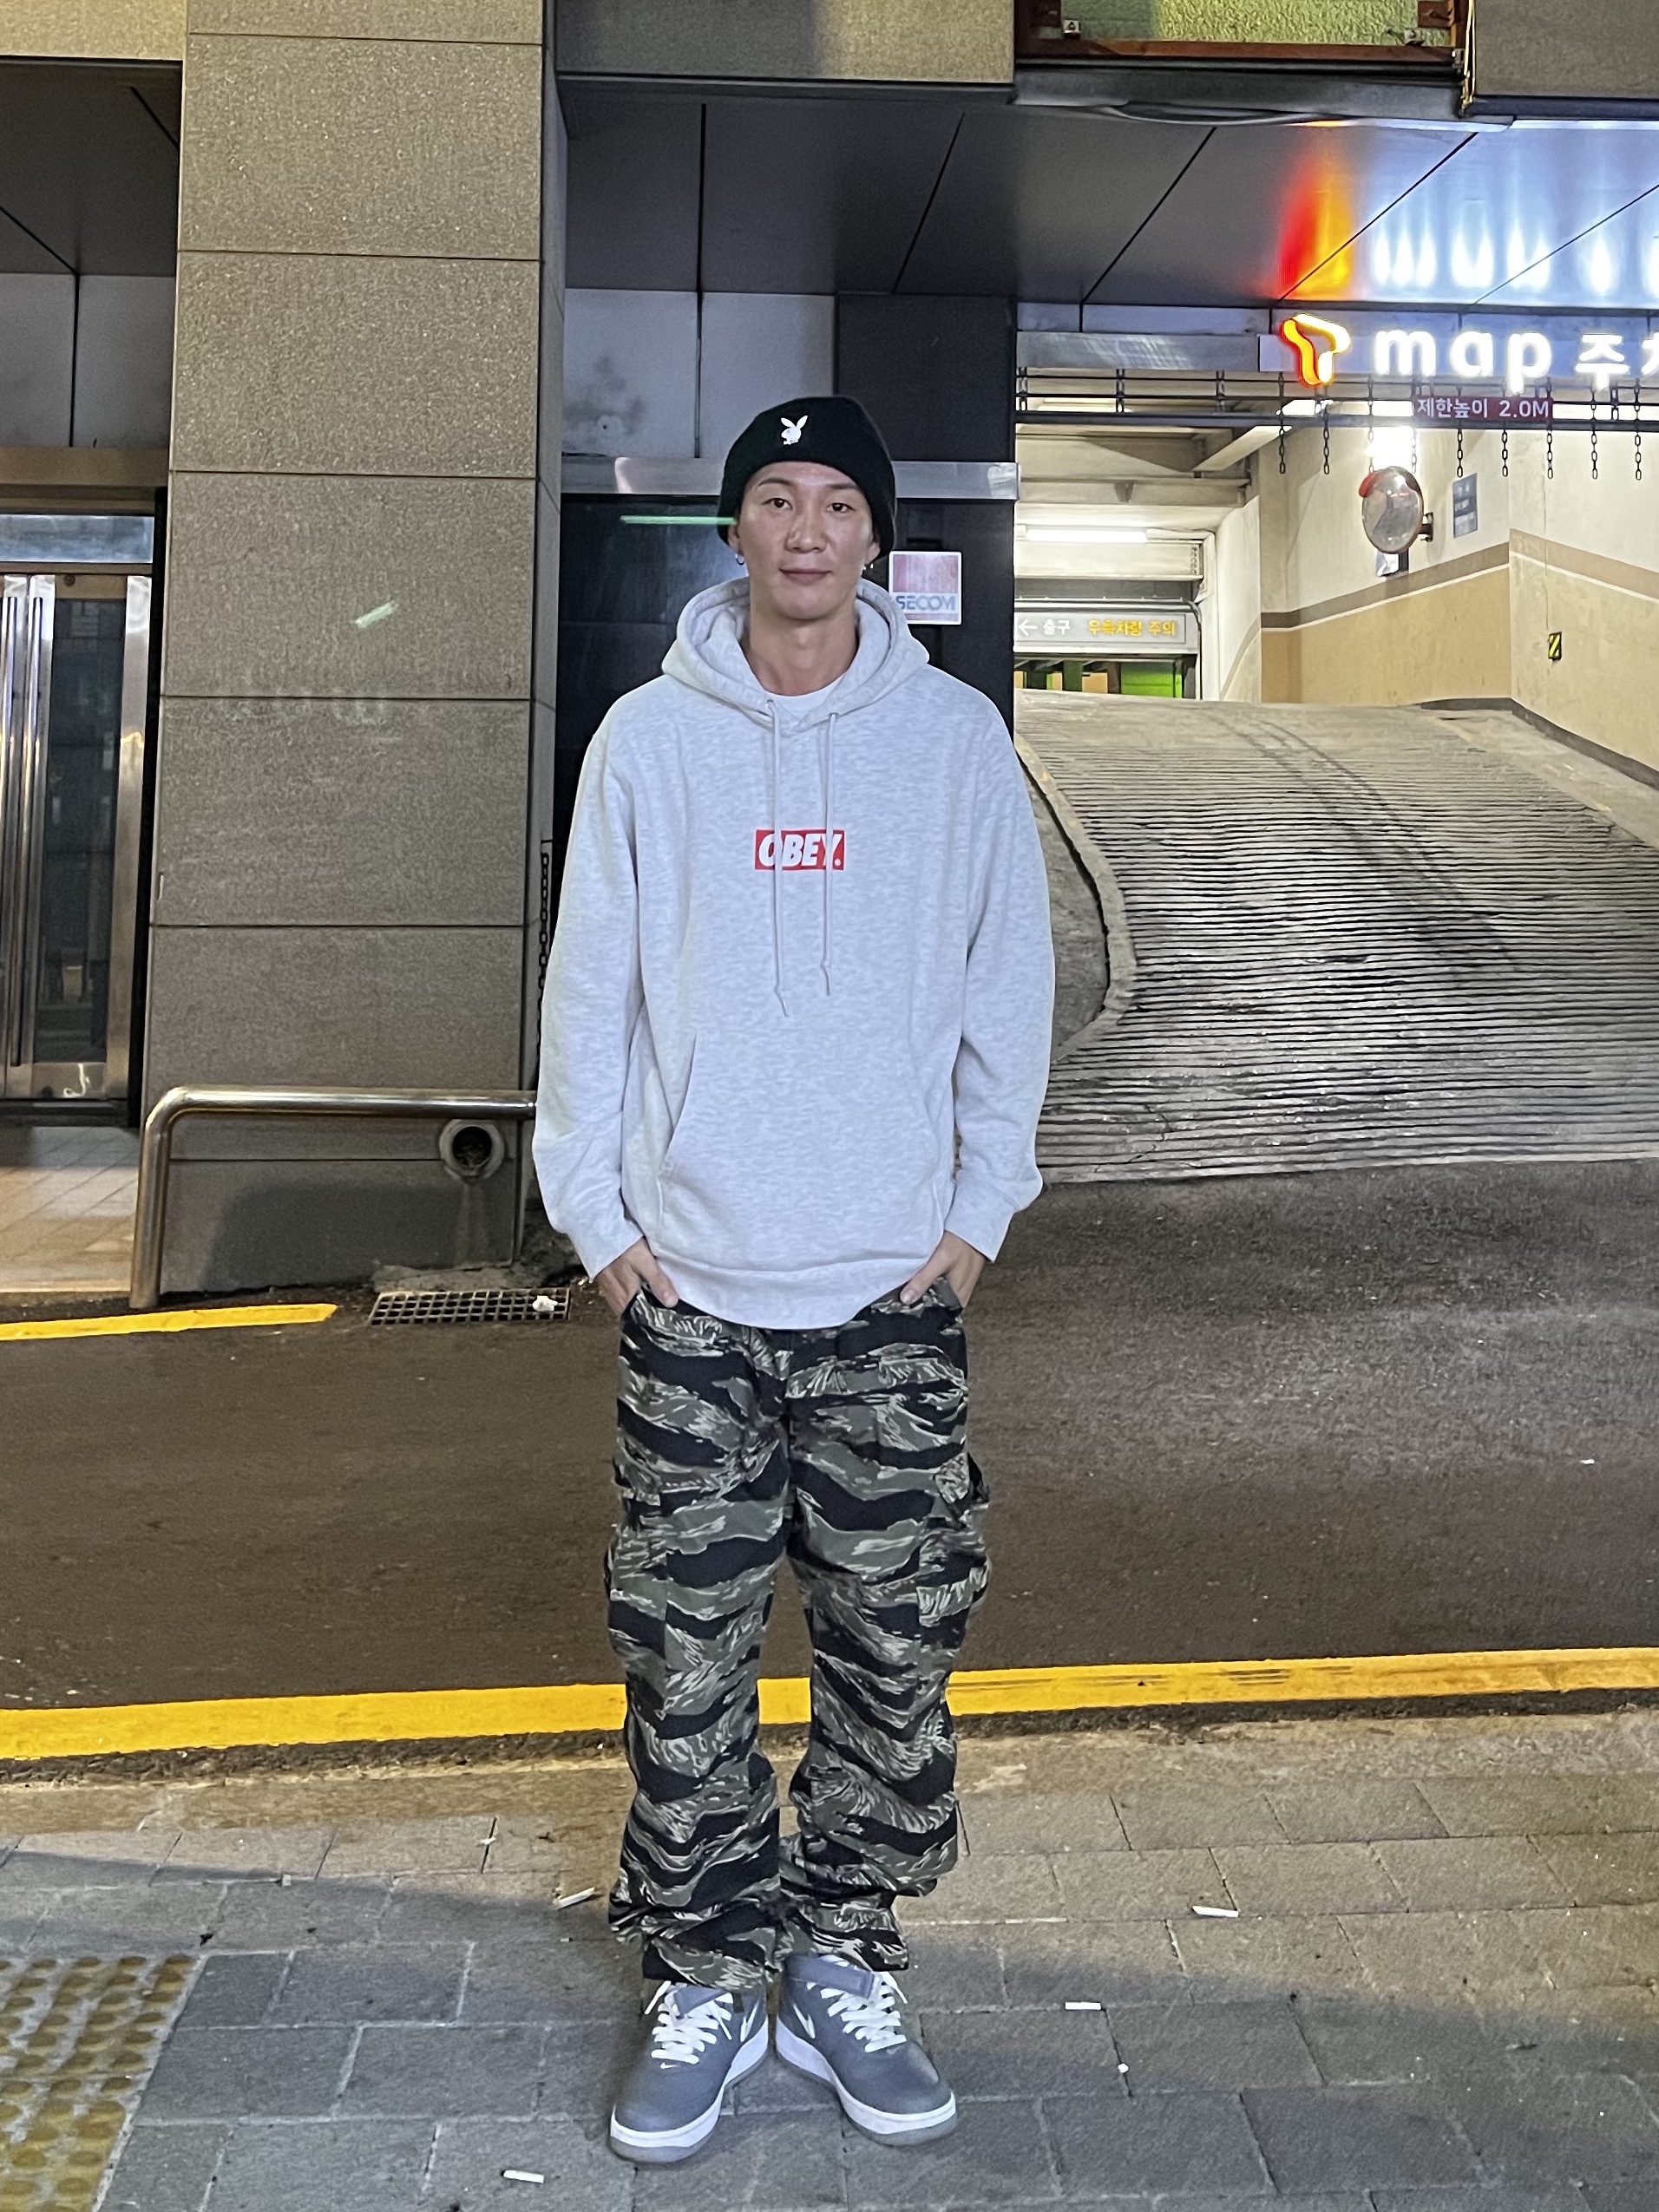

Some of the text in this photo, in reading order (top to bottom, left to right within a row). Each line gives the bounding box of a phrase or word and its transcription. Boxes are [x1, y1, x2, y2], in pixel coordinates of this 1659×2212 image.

[1374, 330, 1552, 393] map
[1417, 397, 1549, 419] 제한높이 2.0M
[895, 595, 956, 611] SECOM
[1043, 618, 1071, 635] 출구
[1147, 620, 1176, 636] 주의
